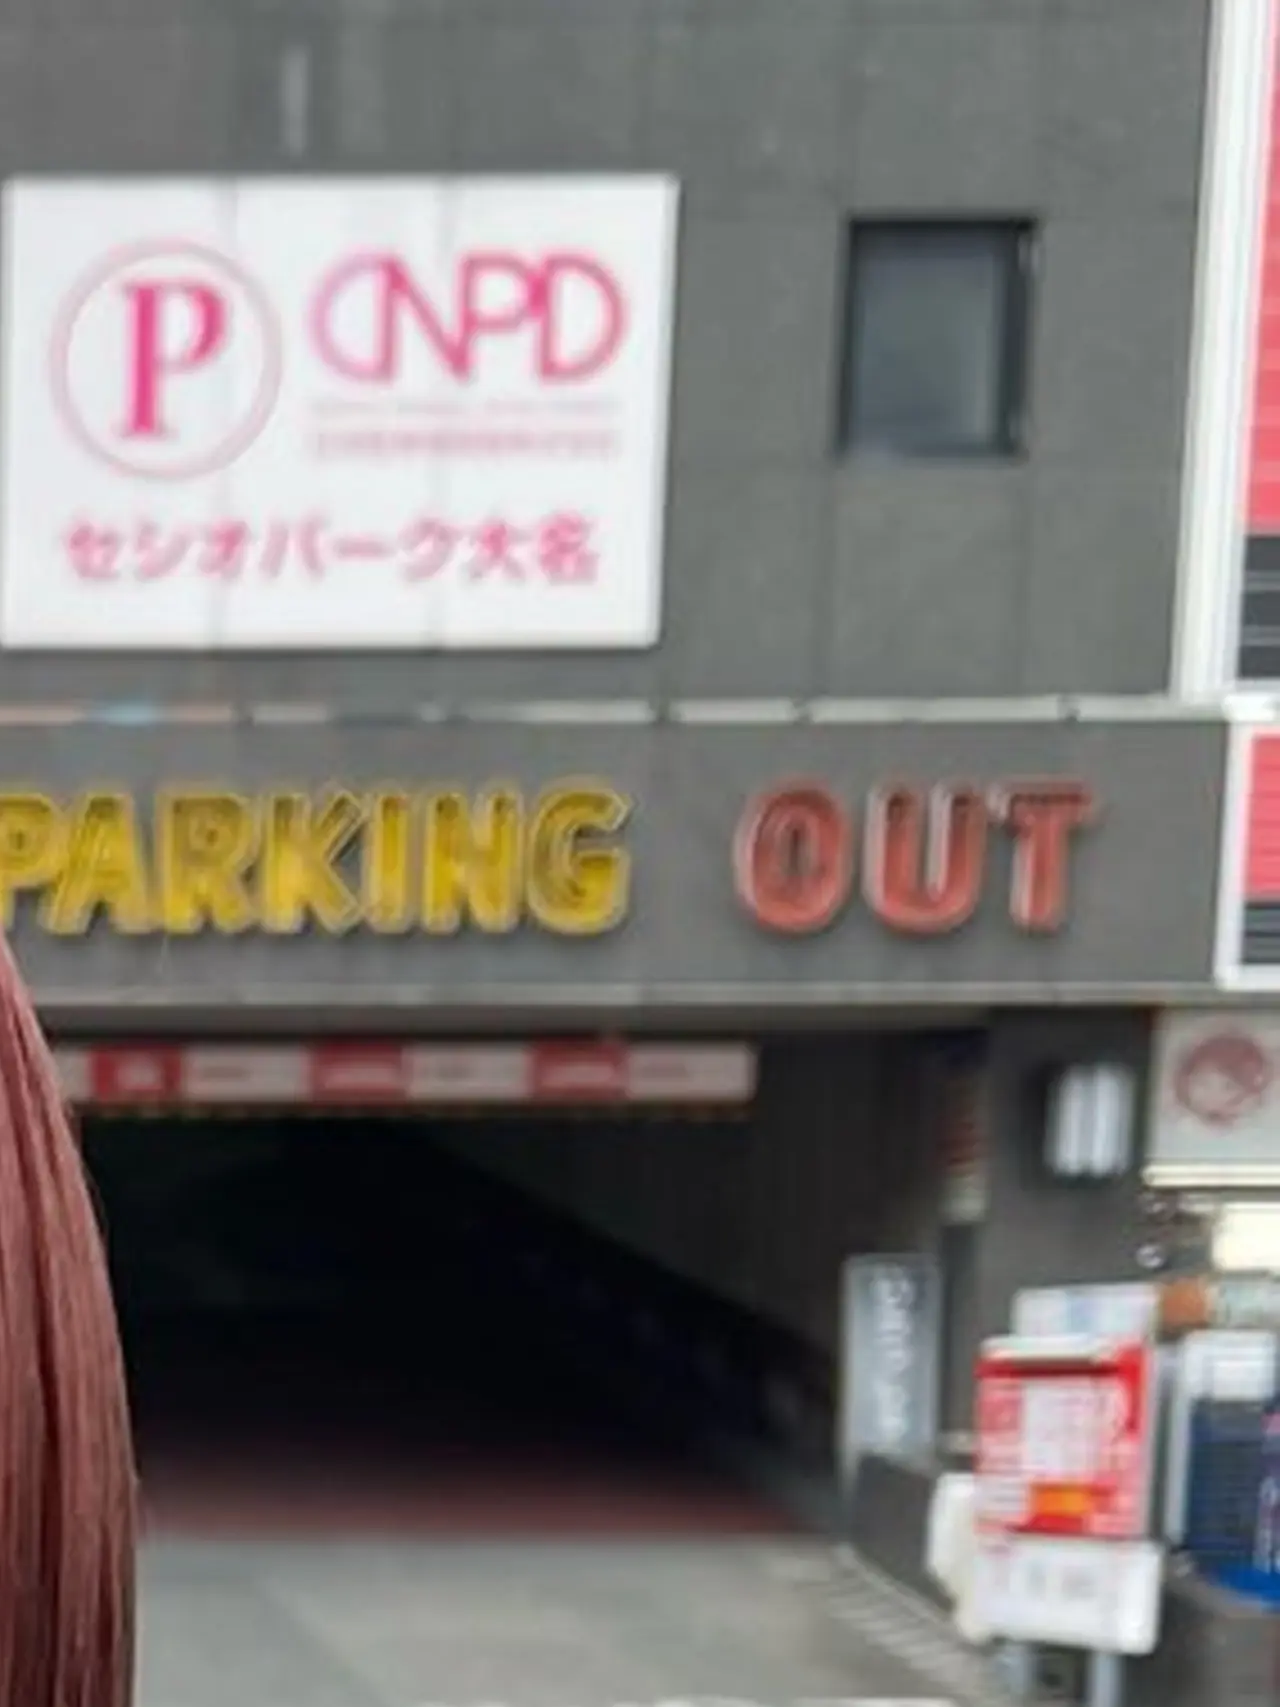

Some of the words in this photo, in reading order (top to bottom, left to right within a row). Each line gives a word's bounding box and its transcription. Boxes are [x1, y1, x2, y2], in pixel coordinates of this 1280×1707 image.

[119, 278, 228, 440] P
[64, 510, 600, 584] セシオパーク大名
[732, 776, 1096, 934] OUT
